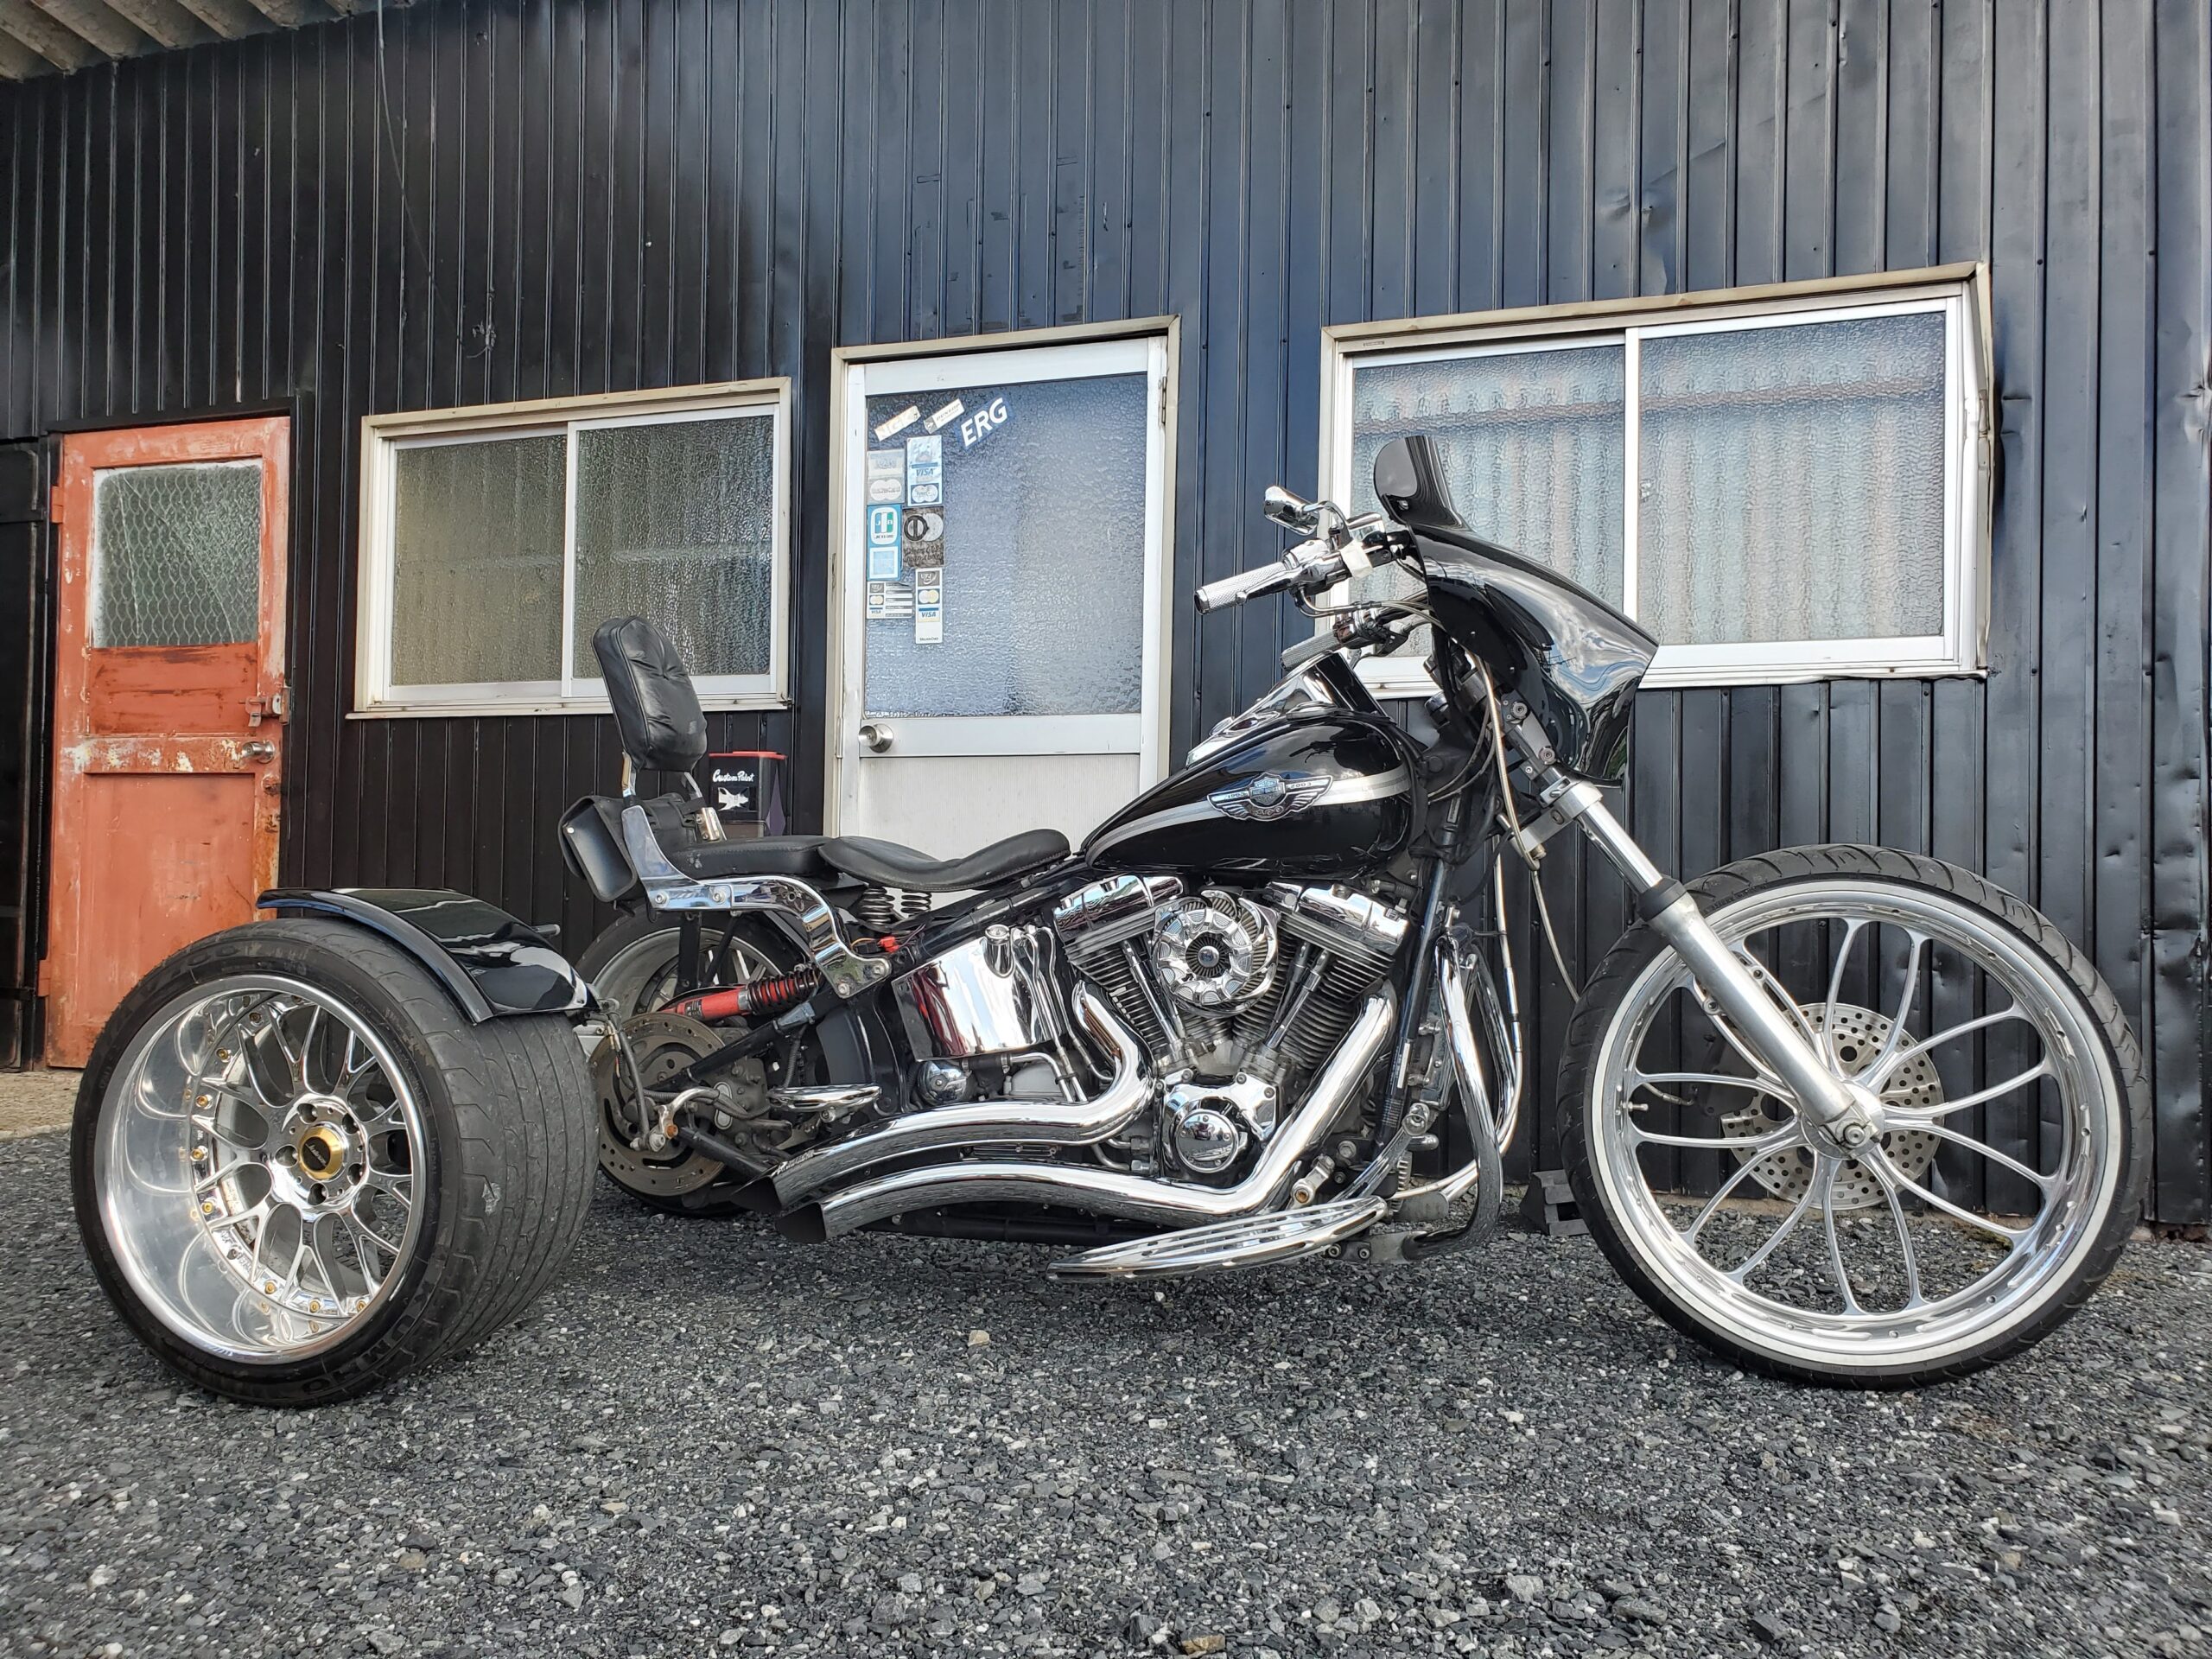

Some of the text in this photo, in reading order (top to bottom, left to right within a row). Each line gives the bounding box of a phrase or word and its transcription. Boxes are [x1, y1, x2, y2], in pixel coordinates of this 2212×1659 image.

[961, 397, 1008, 447] ERG
[713, 769, 755, 783] Custom Paint
[302, 1281, 437, 1395] KUMHO
